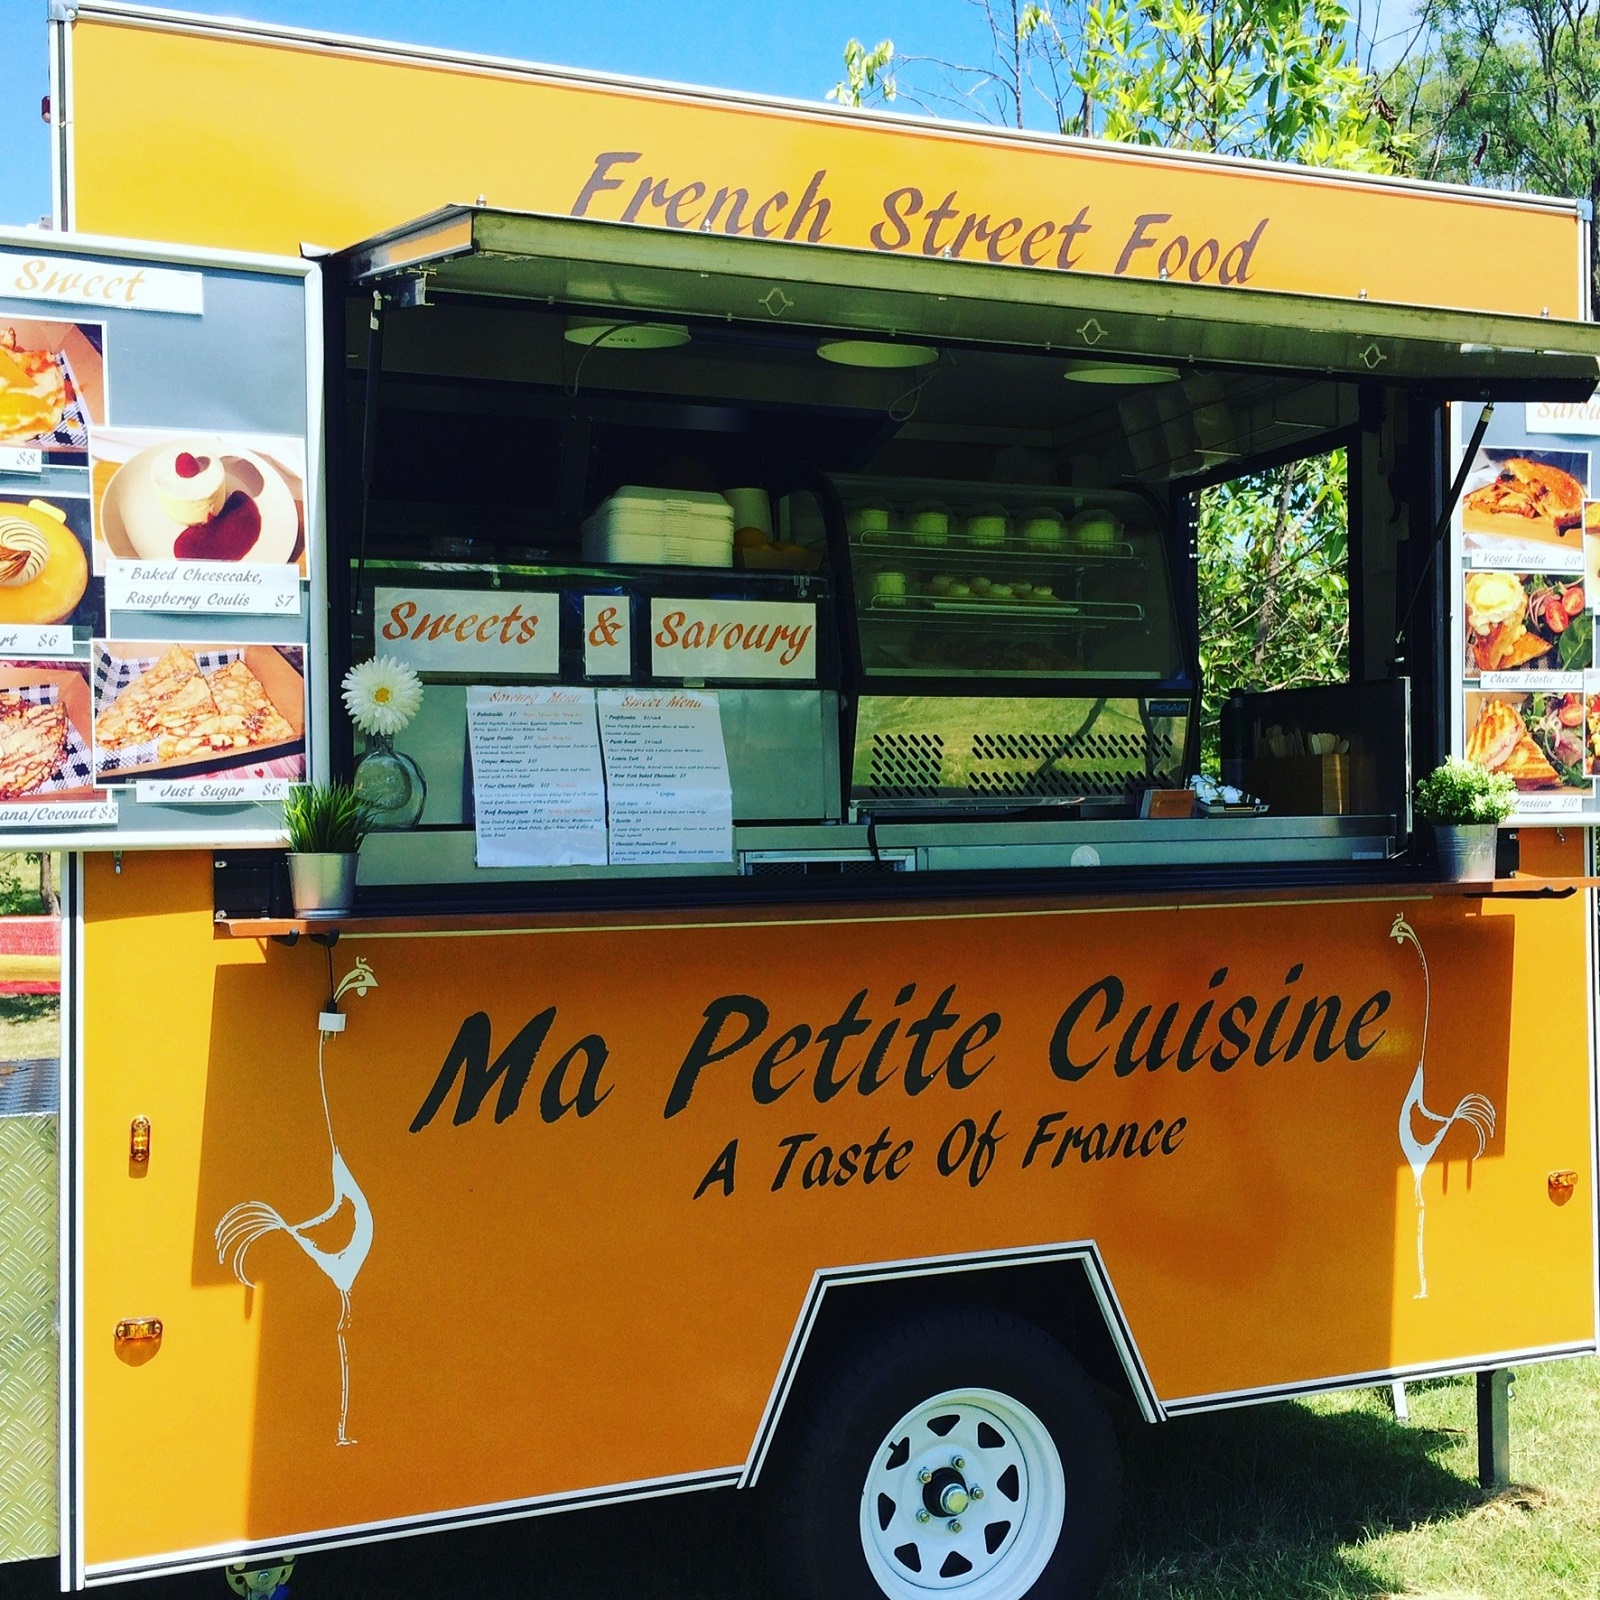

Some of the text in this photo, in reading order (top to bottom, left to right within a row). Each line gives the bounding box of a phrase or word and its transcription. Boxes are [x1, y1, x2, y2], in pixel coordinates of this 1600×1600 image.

[570, 151, 1270, 286] French Street Food
[15, 259, 146, 302] Sweet
[16, 451, 37, 466] $8
[1483, 553, 1581, 567] Veggie Toastie $10
[130, 566, 263, 585] Baked Cheesecake,
[125, 591, 295, 609] Raspberry Coulis $7
[37, 633, 59, 647] $6
[382, 602, 812, 667] Sweets & Savoury
[1490, 673, 1519, 684] Cheese
[1560, 674, 1579, 685] $12
[546, 691, 581, 704] Menu
[621, 695, 702, 708] Sweet Menu
[160, 782, 282, 800] Just Sugar $6
[1562, 797, 1578, 809] $10
[98, 805, 118, 821] $8
[408, 962, 1392, 1133] Ma Petite Cuisine
[693, 1109, 1188, 1201] A Taste Of France
